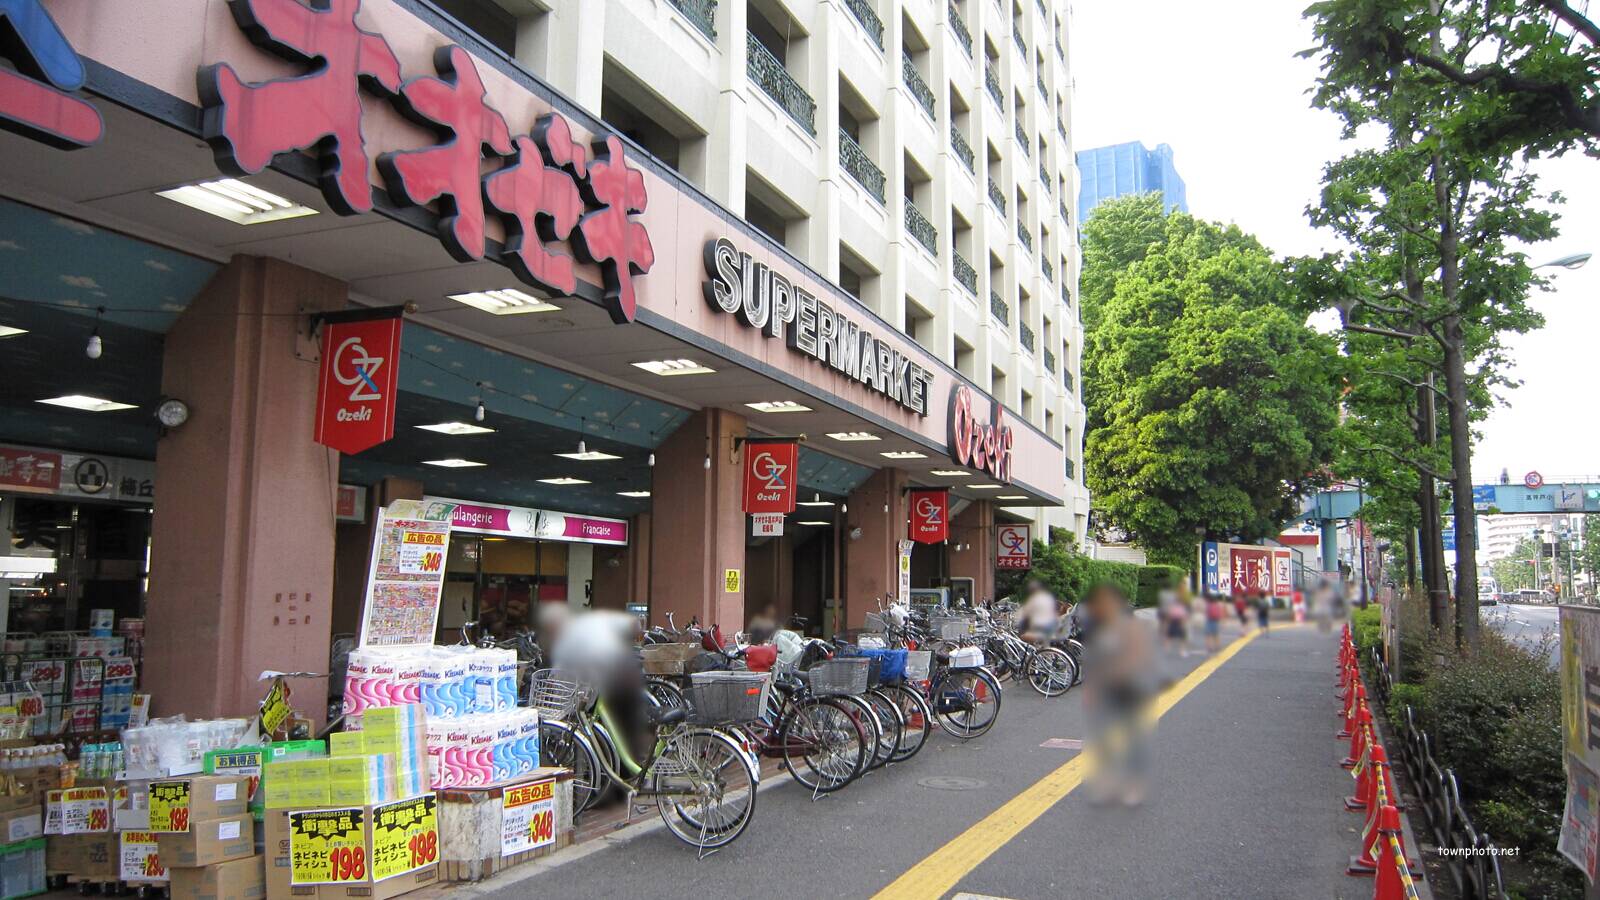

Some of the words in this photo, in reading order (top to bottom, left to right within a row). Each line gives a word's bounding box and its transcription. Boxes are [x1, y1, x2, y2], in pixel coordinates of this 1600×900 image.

[203, 0, 655, 323] オオゼキ
[707, 236, 934, 417] SUPERMARKET
[336, 405, 373, 423] Ozeki
[756, 491, 781, 501] Ozeki
[407, 533, 442, 544] 広告の品
[998, 558, 1028, 567] オオゼキ
[1207, 571, 1217, 585] IN
[510, 784, 551, 804] 広告の品
